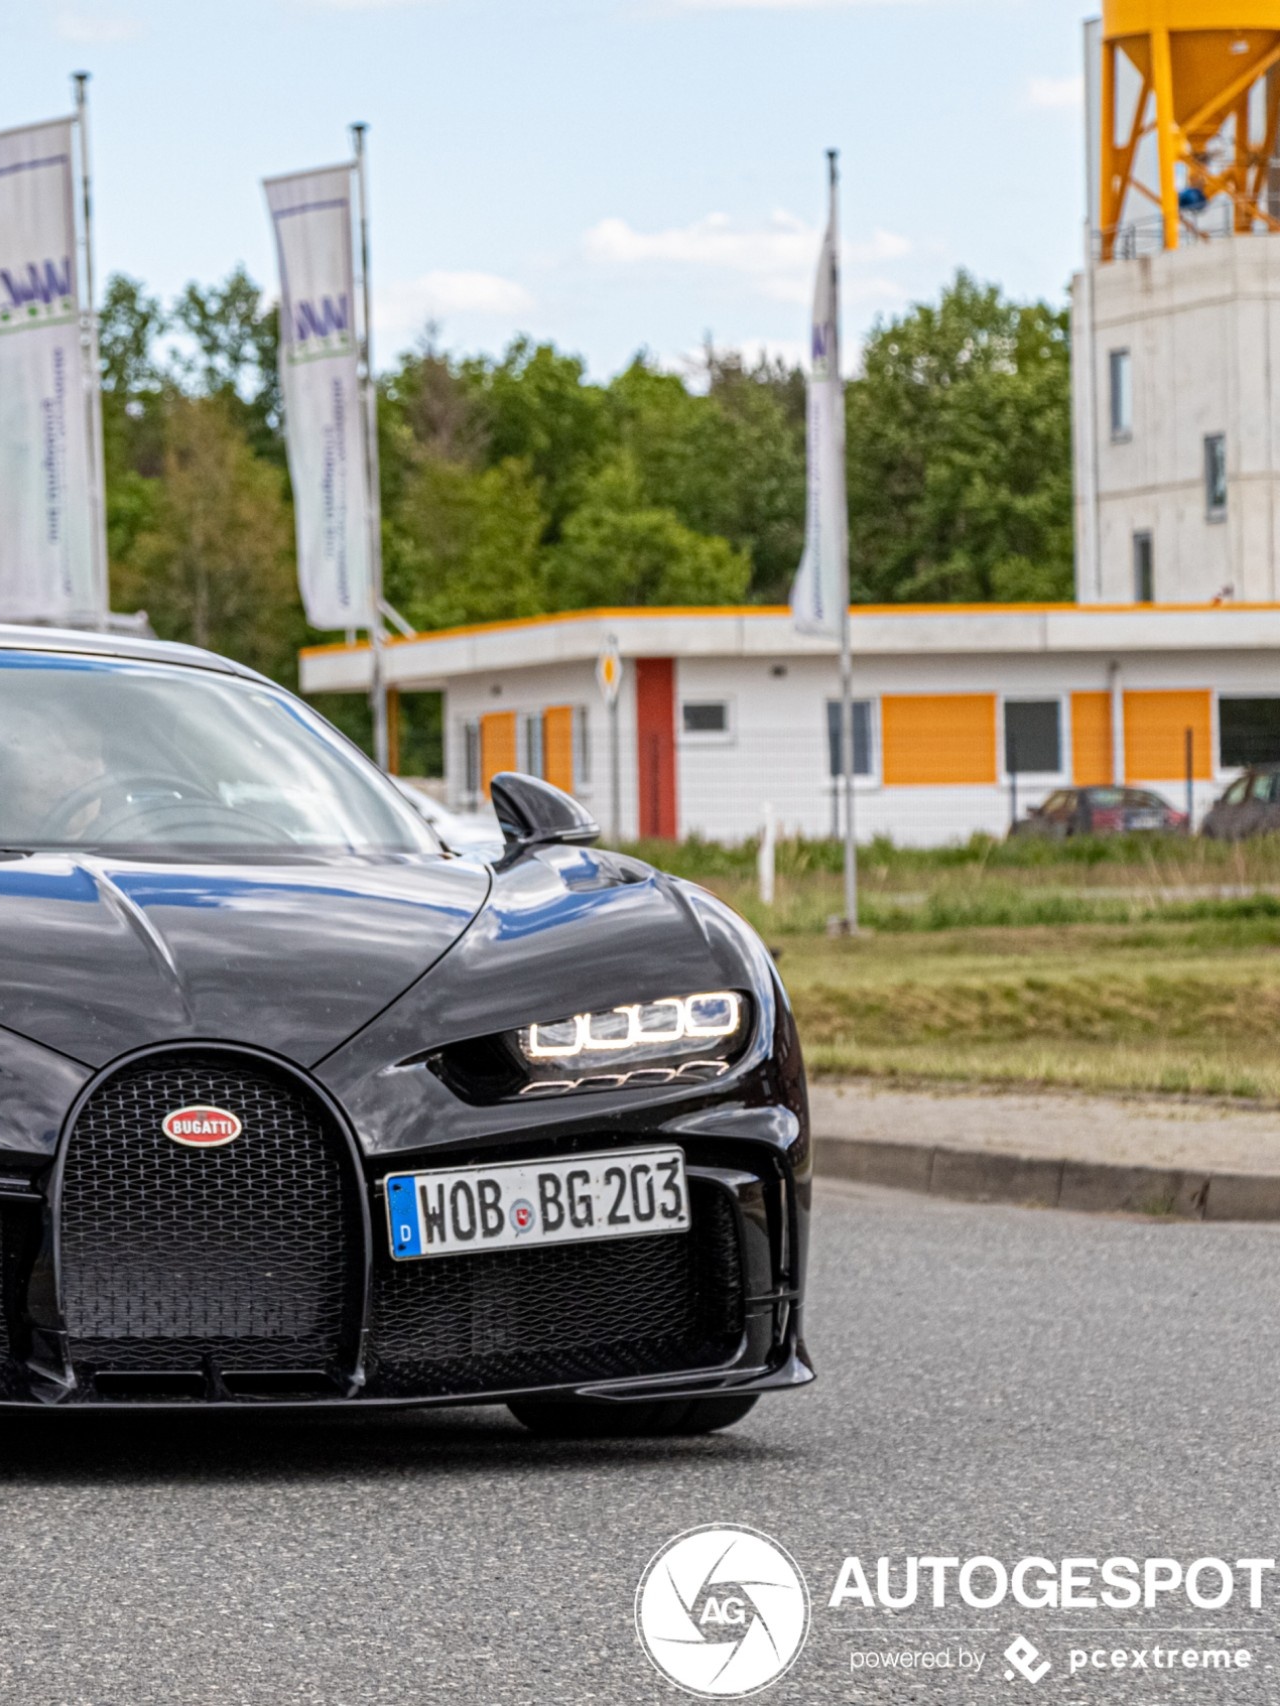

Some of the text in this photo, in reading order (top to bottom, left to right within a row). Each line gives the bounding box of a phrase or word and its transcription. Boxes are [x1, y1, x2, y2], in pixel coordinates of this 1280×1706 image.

[172, 1120, 232, 1135] BUGATTI
[419, 1161, 682, 1244] WOB BG 203
[400, 1224, 412, 1242] D
